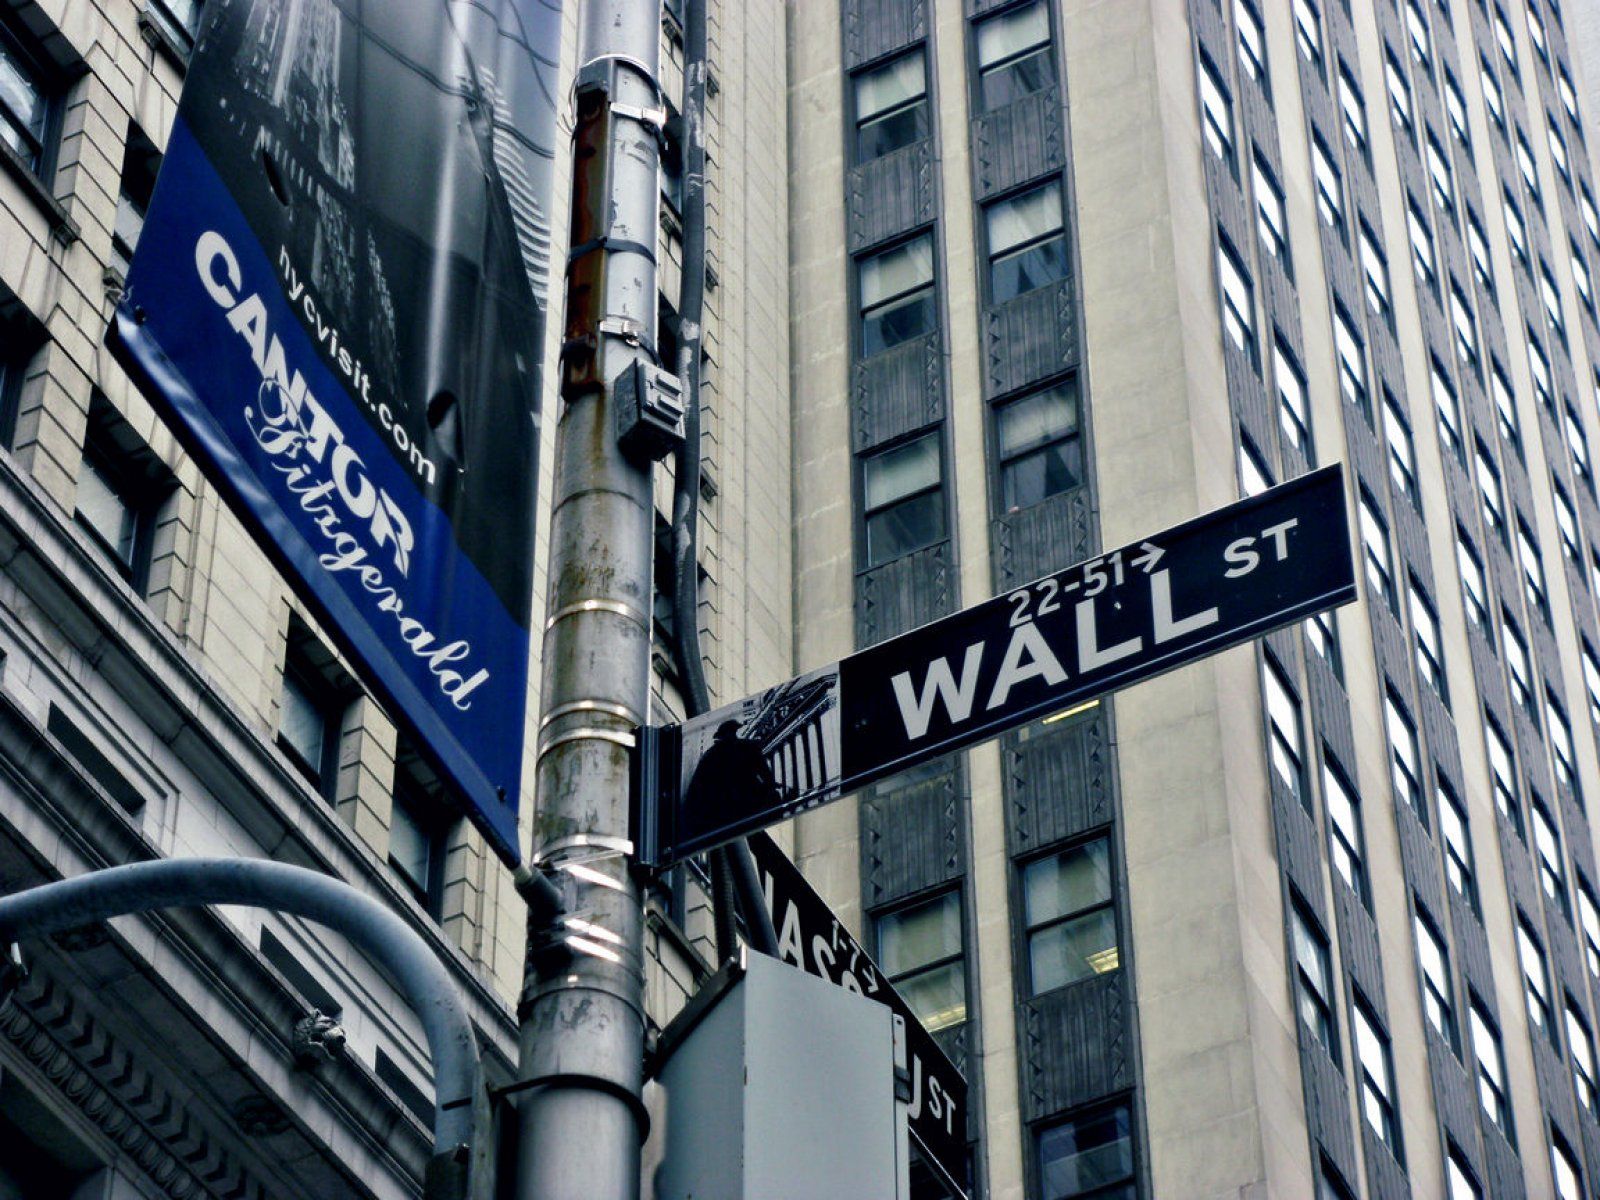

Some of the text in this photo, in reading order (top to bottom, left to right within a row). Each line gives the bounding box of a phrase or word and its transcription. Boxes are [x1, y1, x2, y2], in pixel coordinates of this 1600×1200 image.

[195, 230, 414, 579] CANTOR
[279, 245, 436, 486] nycvisit.com
[244, 376, 490, 711] Fitzgerald
[891, 517, 1298, 740] WALL ST
[1008, 553, 1126, 627] 22-51
[928, 1075, 956, 1134] ST
